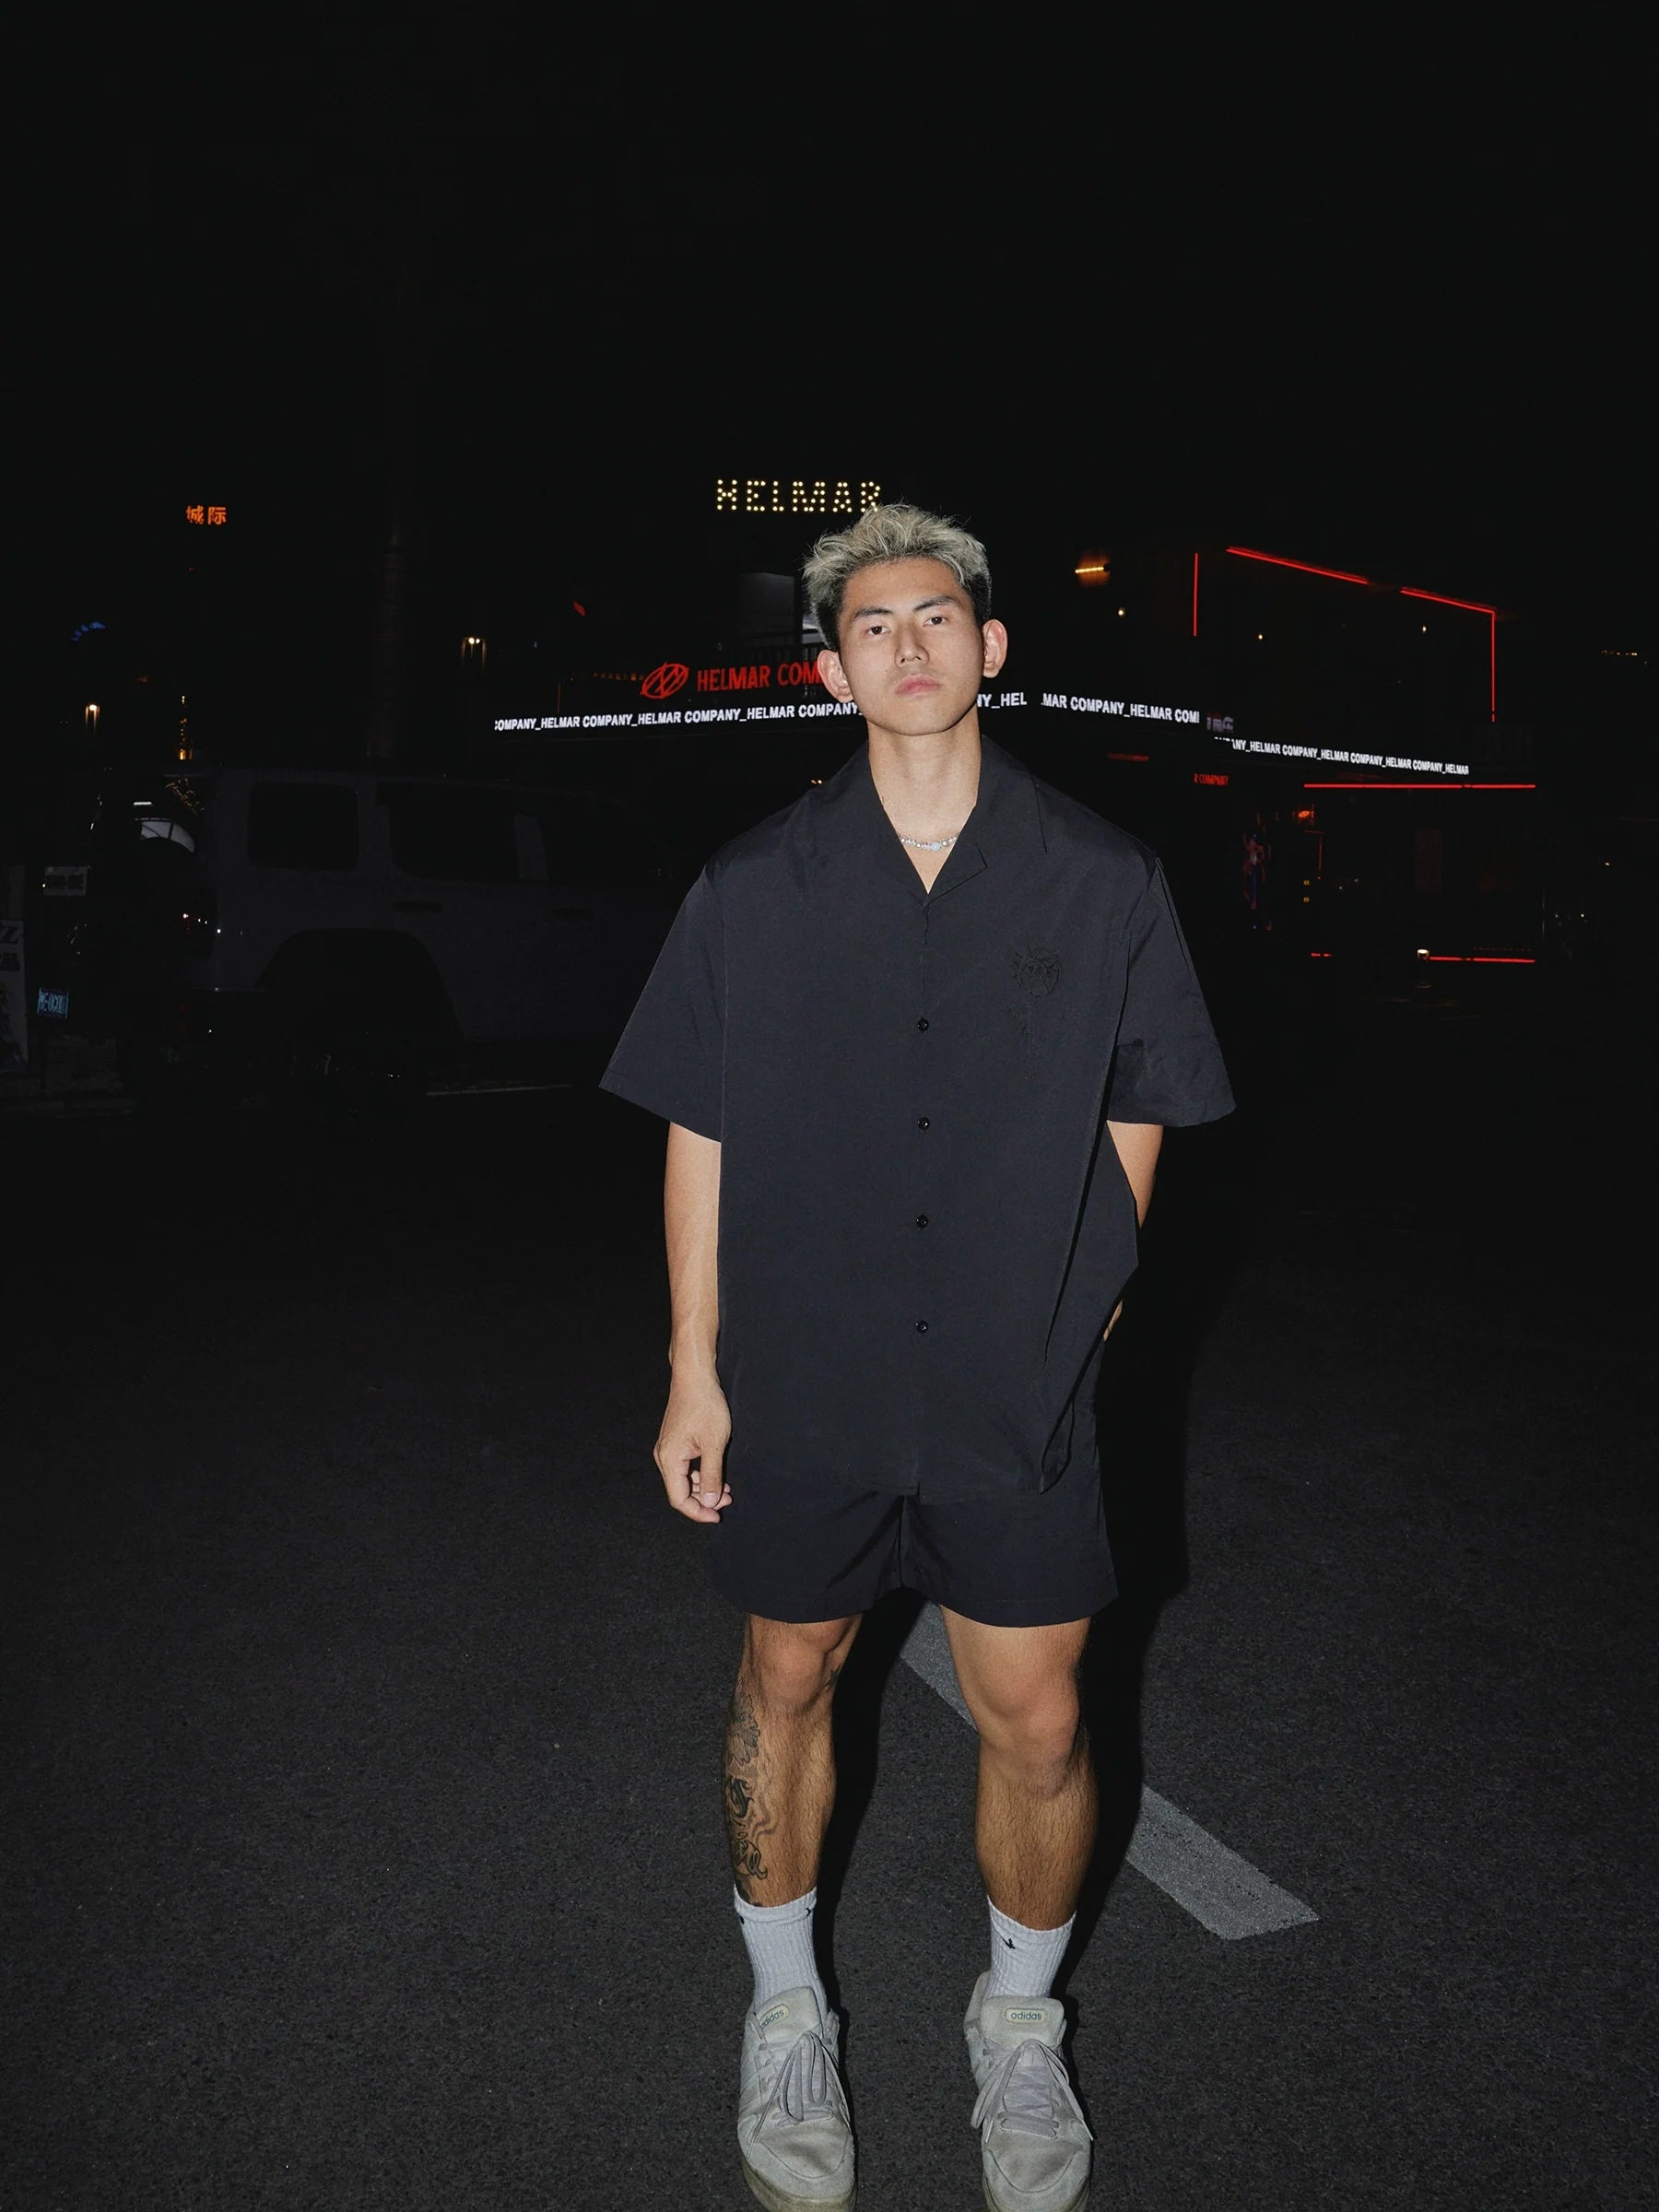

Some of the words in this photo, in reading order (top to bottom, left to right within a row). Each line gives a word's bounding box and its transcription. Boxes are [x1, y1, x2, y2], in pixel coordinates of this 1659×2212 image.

[717, 479, 880, 512] HELMAR
[186, 505, 227, 525] 城际
[698, 665, 771, 691] HELMAR
[582, 712, 681, 728] COMPANY_HELMAR
[684, 705, 794, 724] COMPANY_HELMAR
[1041, 693, 1067, 709] MAR
[1070, 697, 1172, 721] COMPANY_HELMAR
[1282, 745, 1349, 762] COMPANY_HELMAR
[1010, 2010, 1041, 2021] adidas
